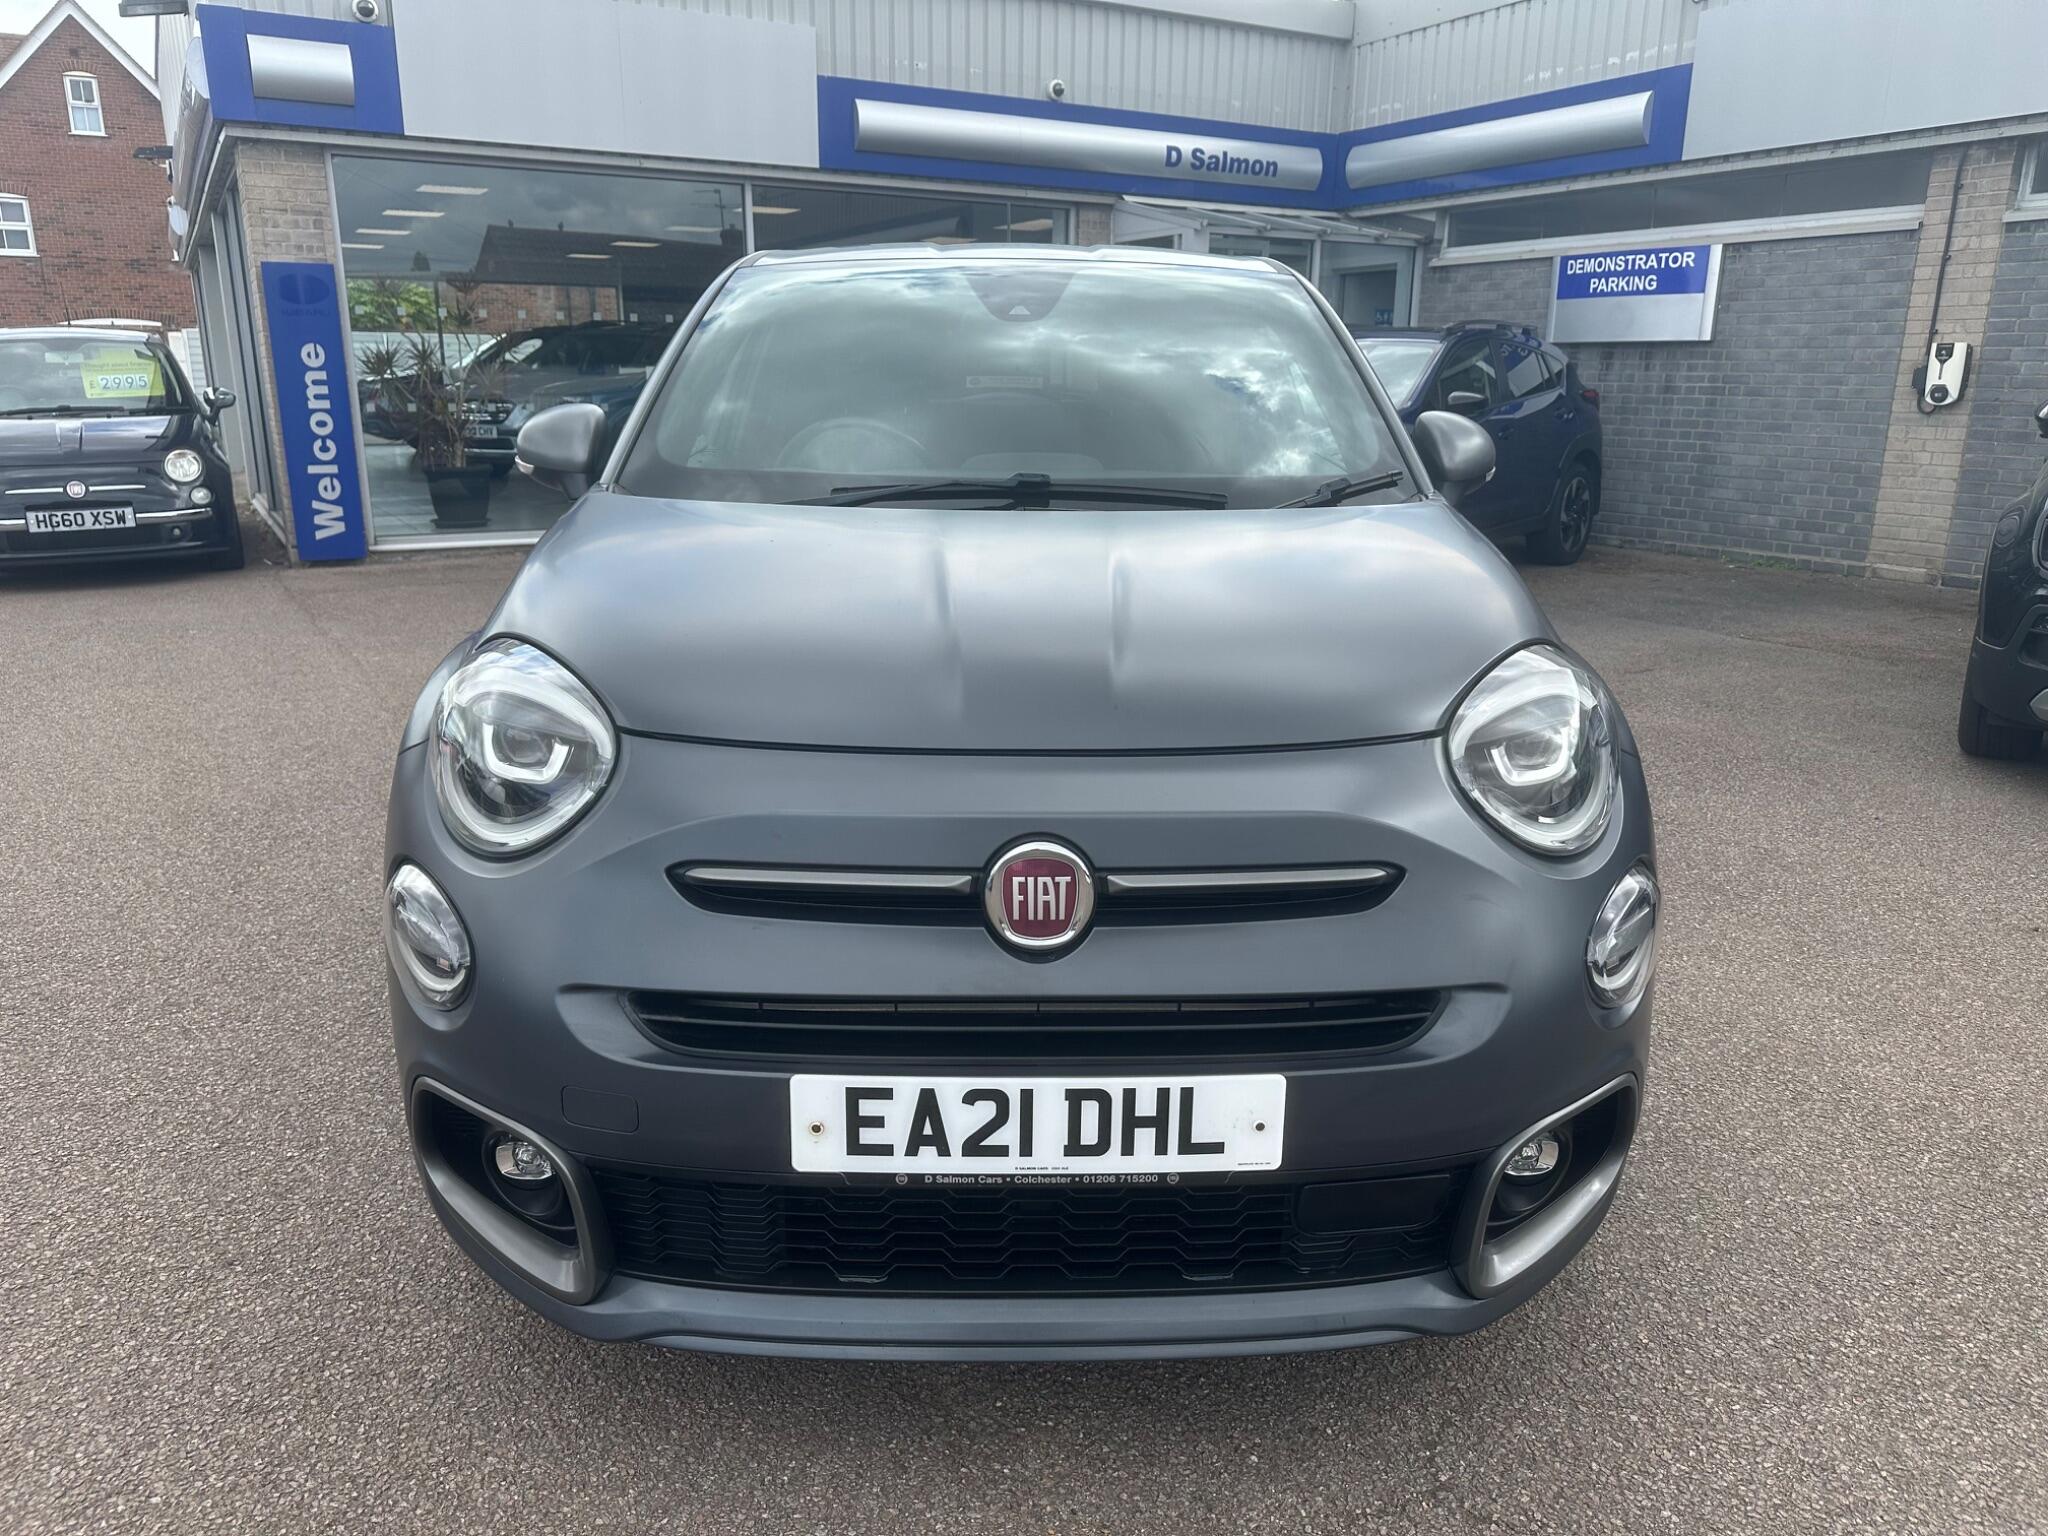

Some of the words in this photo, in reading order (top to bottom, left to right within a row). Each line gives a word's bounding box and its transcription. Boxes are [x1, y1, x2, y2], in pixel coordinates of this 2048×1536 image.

[1165, 145, 1182, 168] D
[1190, 147, 1278, 178] Salmon
[1567, 251, 1695, 275] DEMONSTRATOR
[1589, 275, 1658, 293] PARKING
[100, 376, 147, 389] 2995
[301, 342, 346, 540] Welcome
[35, 512, 86, 529] HG60
[90, 510, 127, 526] XSW
[1012, 876, 1072, 920] FIAT
[845, 1087, 1034, 1157] EA21
[1063, 1087, 1225, 1156] DHL
[924, 1175, 933, 1183] D
[936, 1175, 975, 1183] Salmon
[978, 1175, 1003, 1184] Cars
[1014, 1175, 1071, 1184] Colchester
[1083, 1175, 1116, 1183] 01206
[1119, 1175, 1158, 1183] 715200
